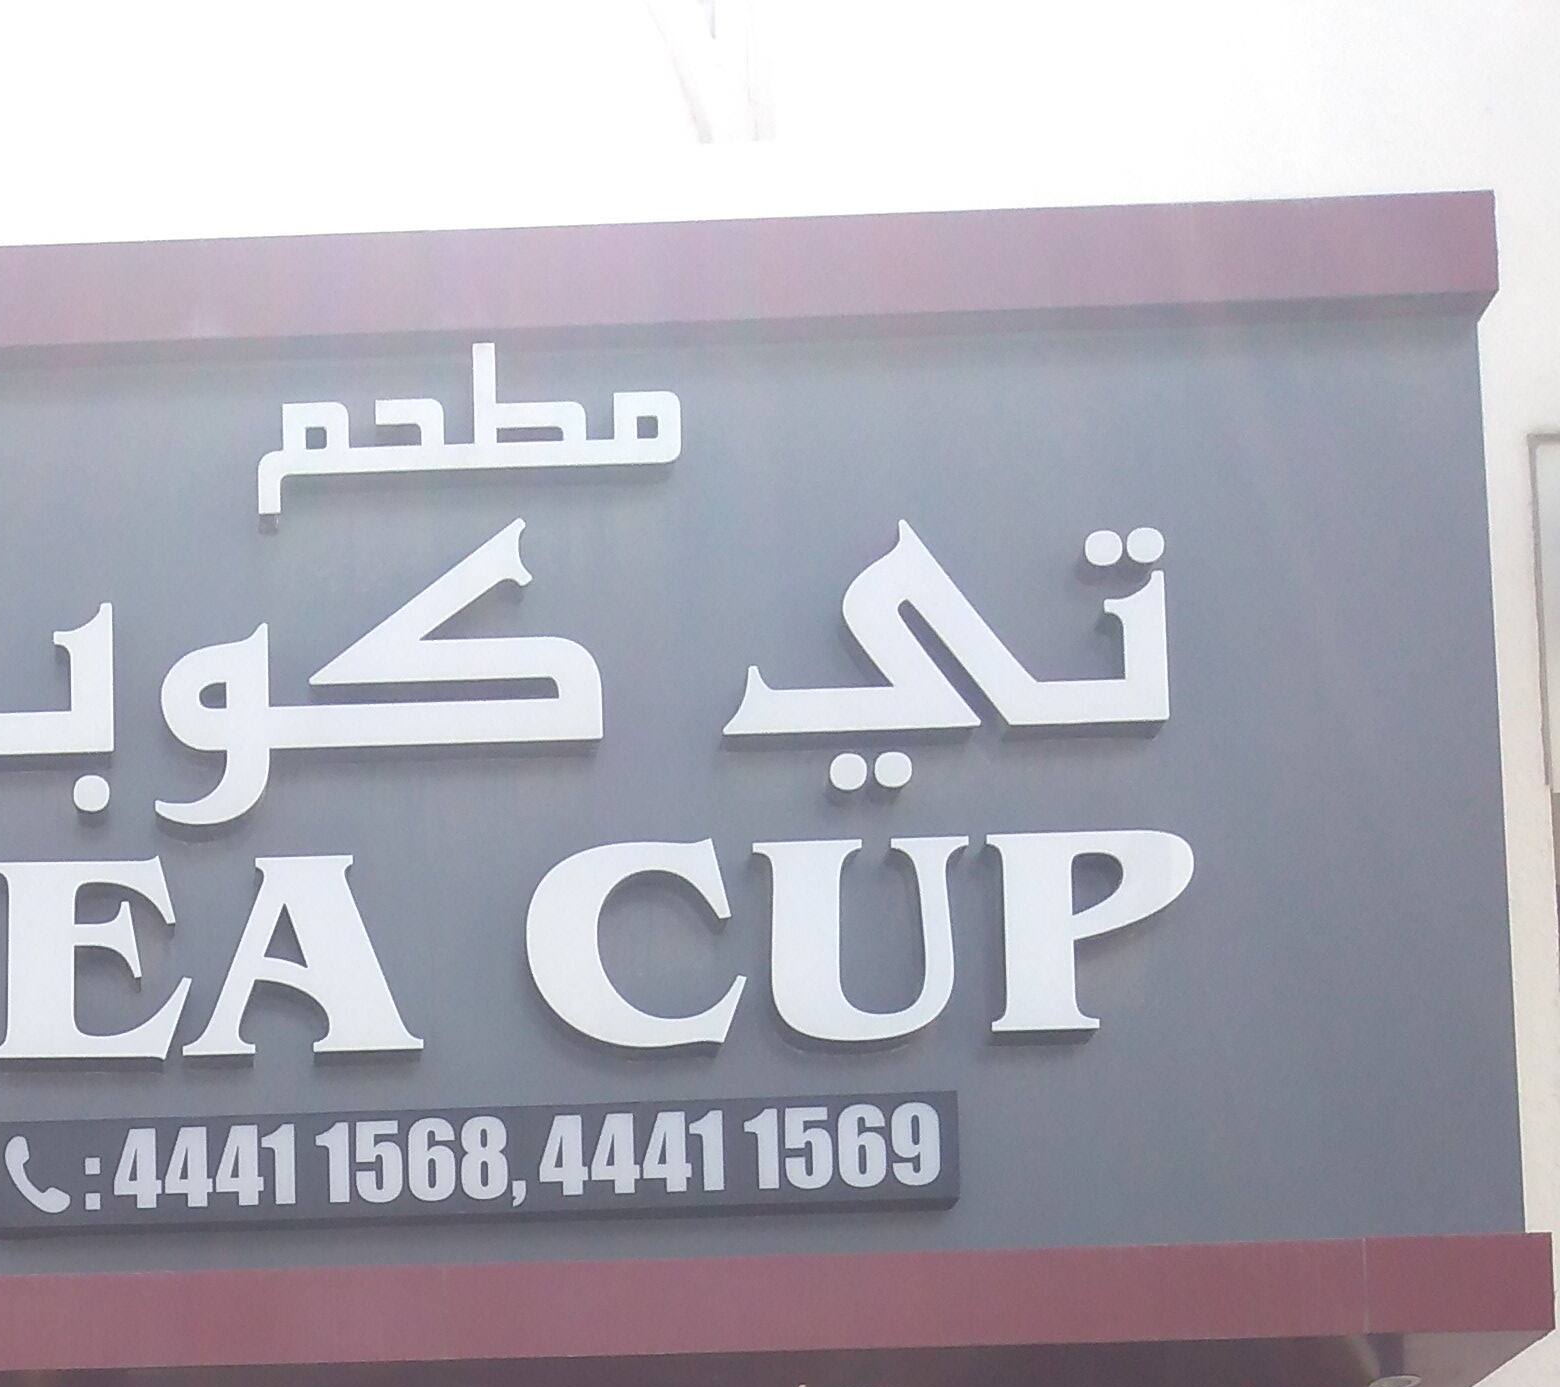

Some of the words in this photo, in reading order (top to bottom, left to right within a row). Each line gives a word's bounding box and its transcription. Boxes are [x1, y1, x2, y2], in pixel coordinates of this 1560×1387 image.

[722, 518, 1170, 790] تي
[525, 829, 1195, 1048] CUP
[315, 1115, 527, 1207] 1568,
[539, 1109, 725, 1196] 4441
[743, 1102, 941, 1190] 1569
